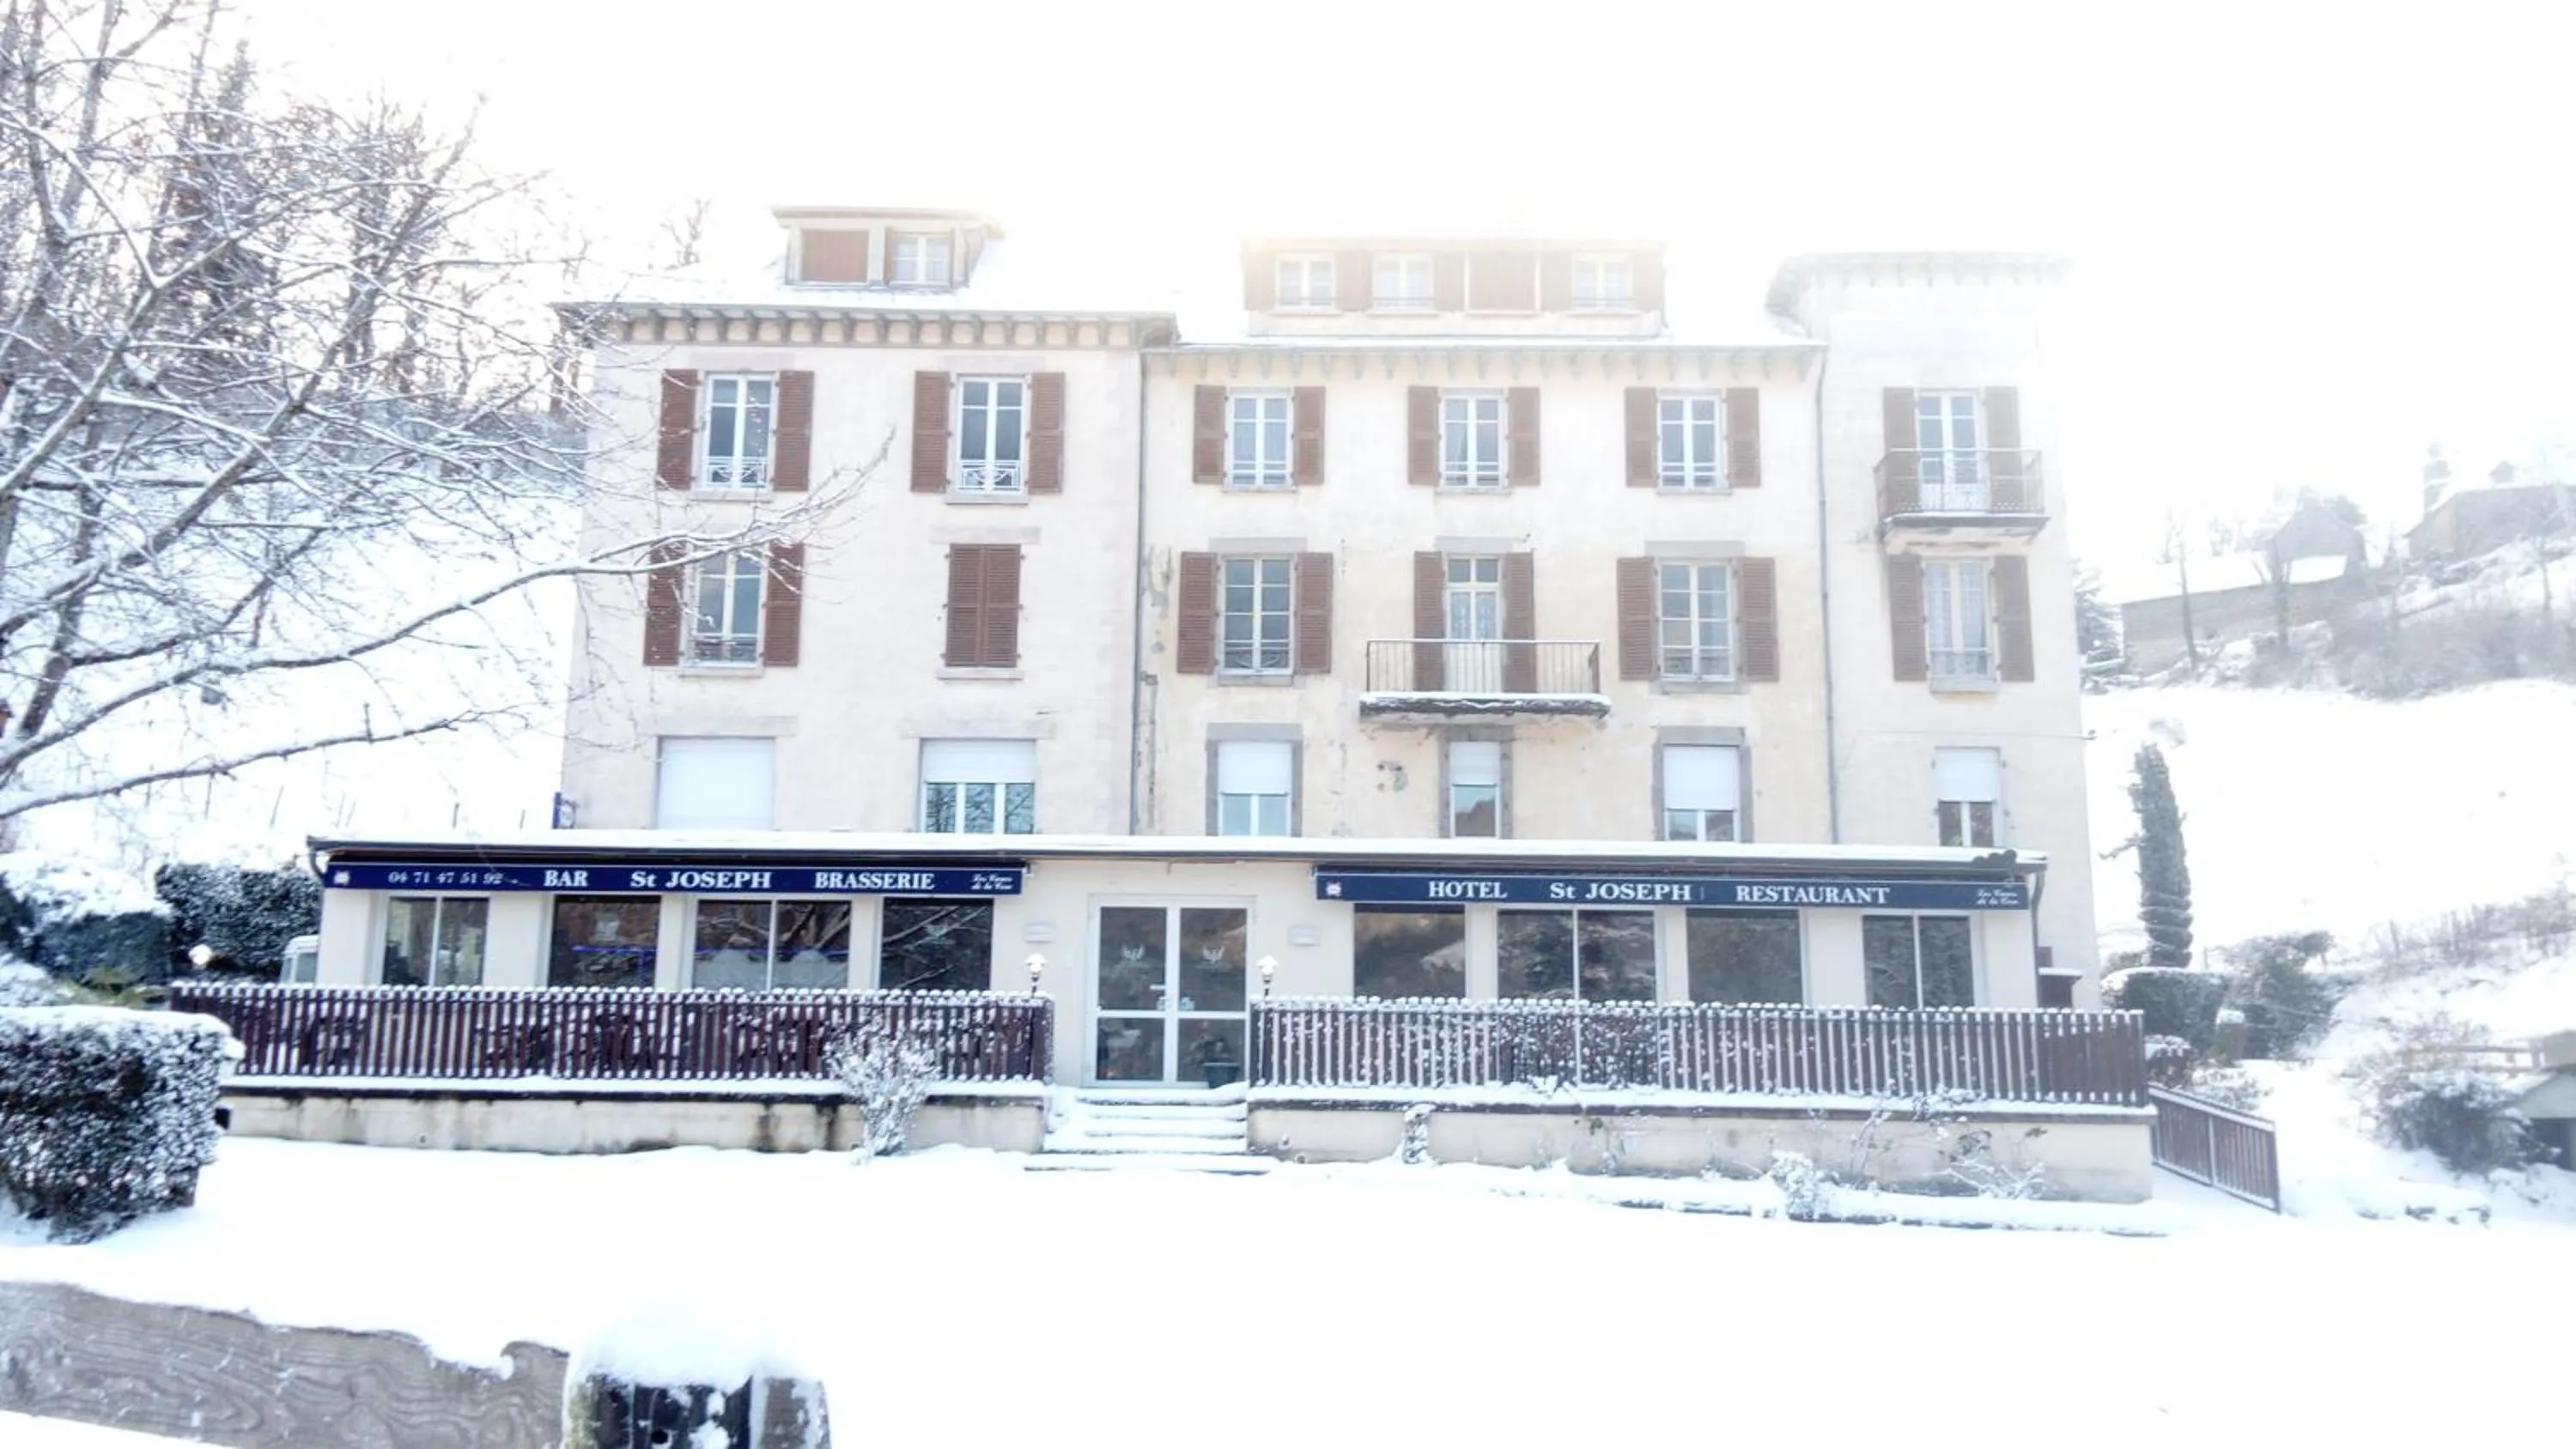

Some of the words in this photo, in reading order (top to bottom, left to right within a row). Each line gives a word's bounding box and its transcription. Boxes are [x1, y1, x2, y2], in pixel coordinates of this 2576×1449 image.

[388, 871, 408, 883] 04
[413, 871, 430, 883] 71
[436, 871, 455, 883] 47
[459, 872, 477, 884] 51
[483, 872, 503, 885] 92
[544, 870, 588, 888] BAR
[630, 870, 656, 888] St
[665, 871, 772, 889] JOSEPH
[815, 872, 935, 890] BRASSERIE
[1428, 881, 1508, 900] HOTEL
[1549, 882, 1576, 900] St
[1584, 882, 1692, 901] JOSEPH
[1735, 885, 1891, 905] RESTAURANT
